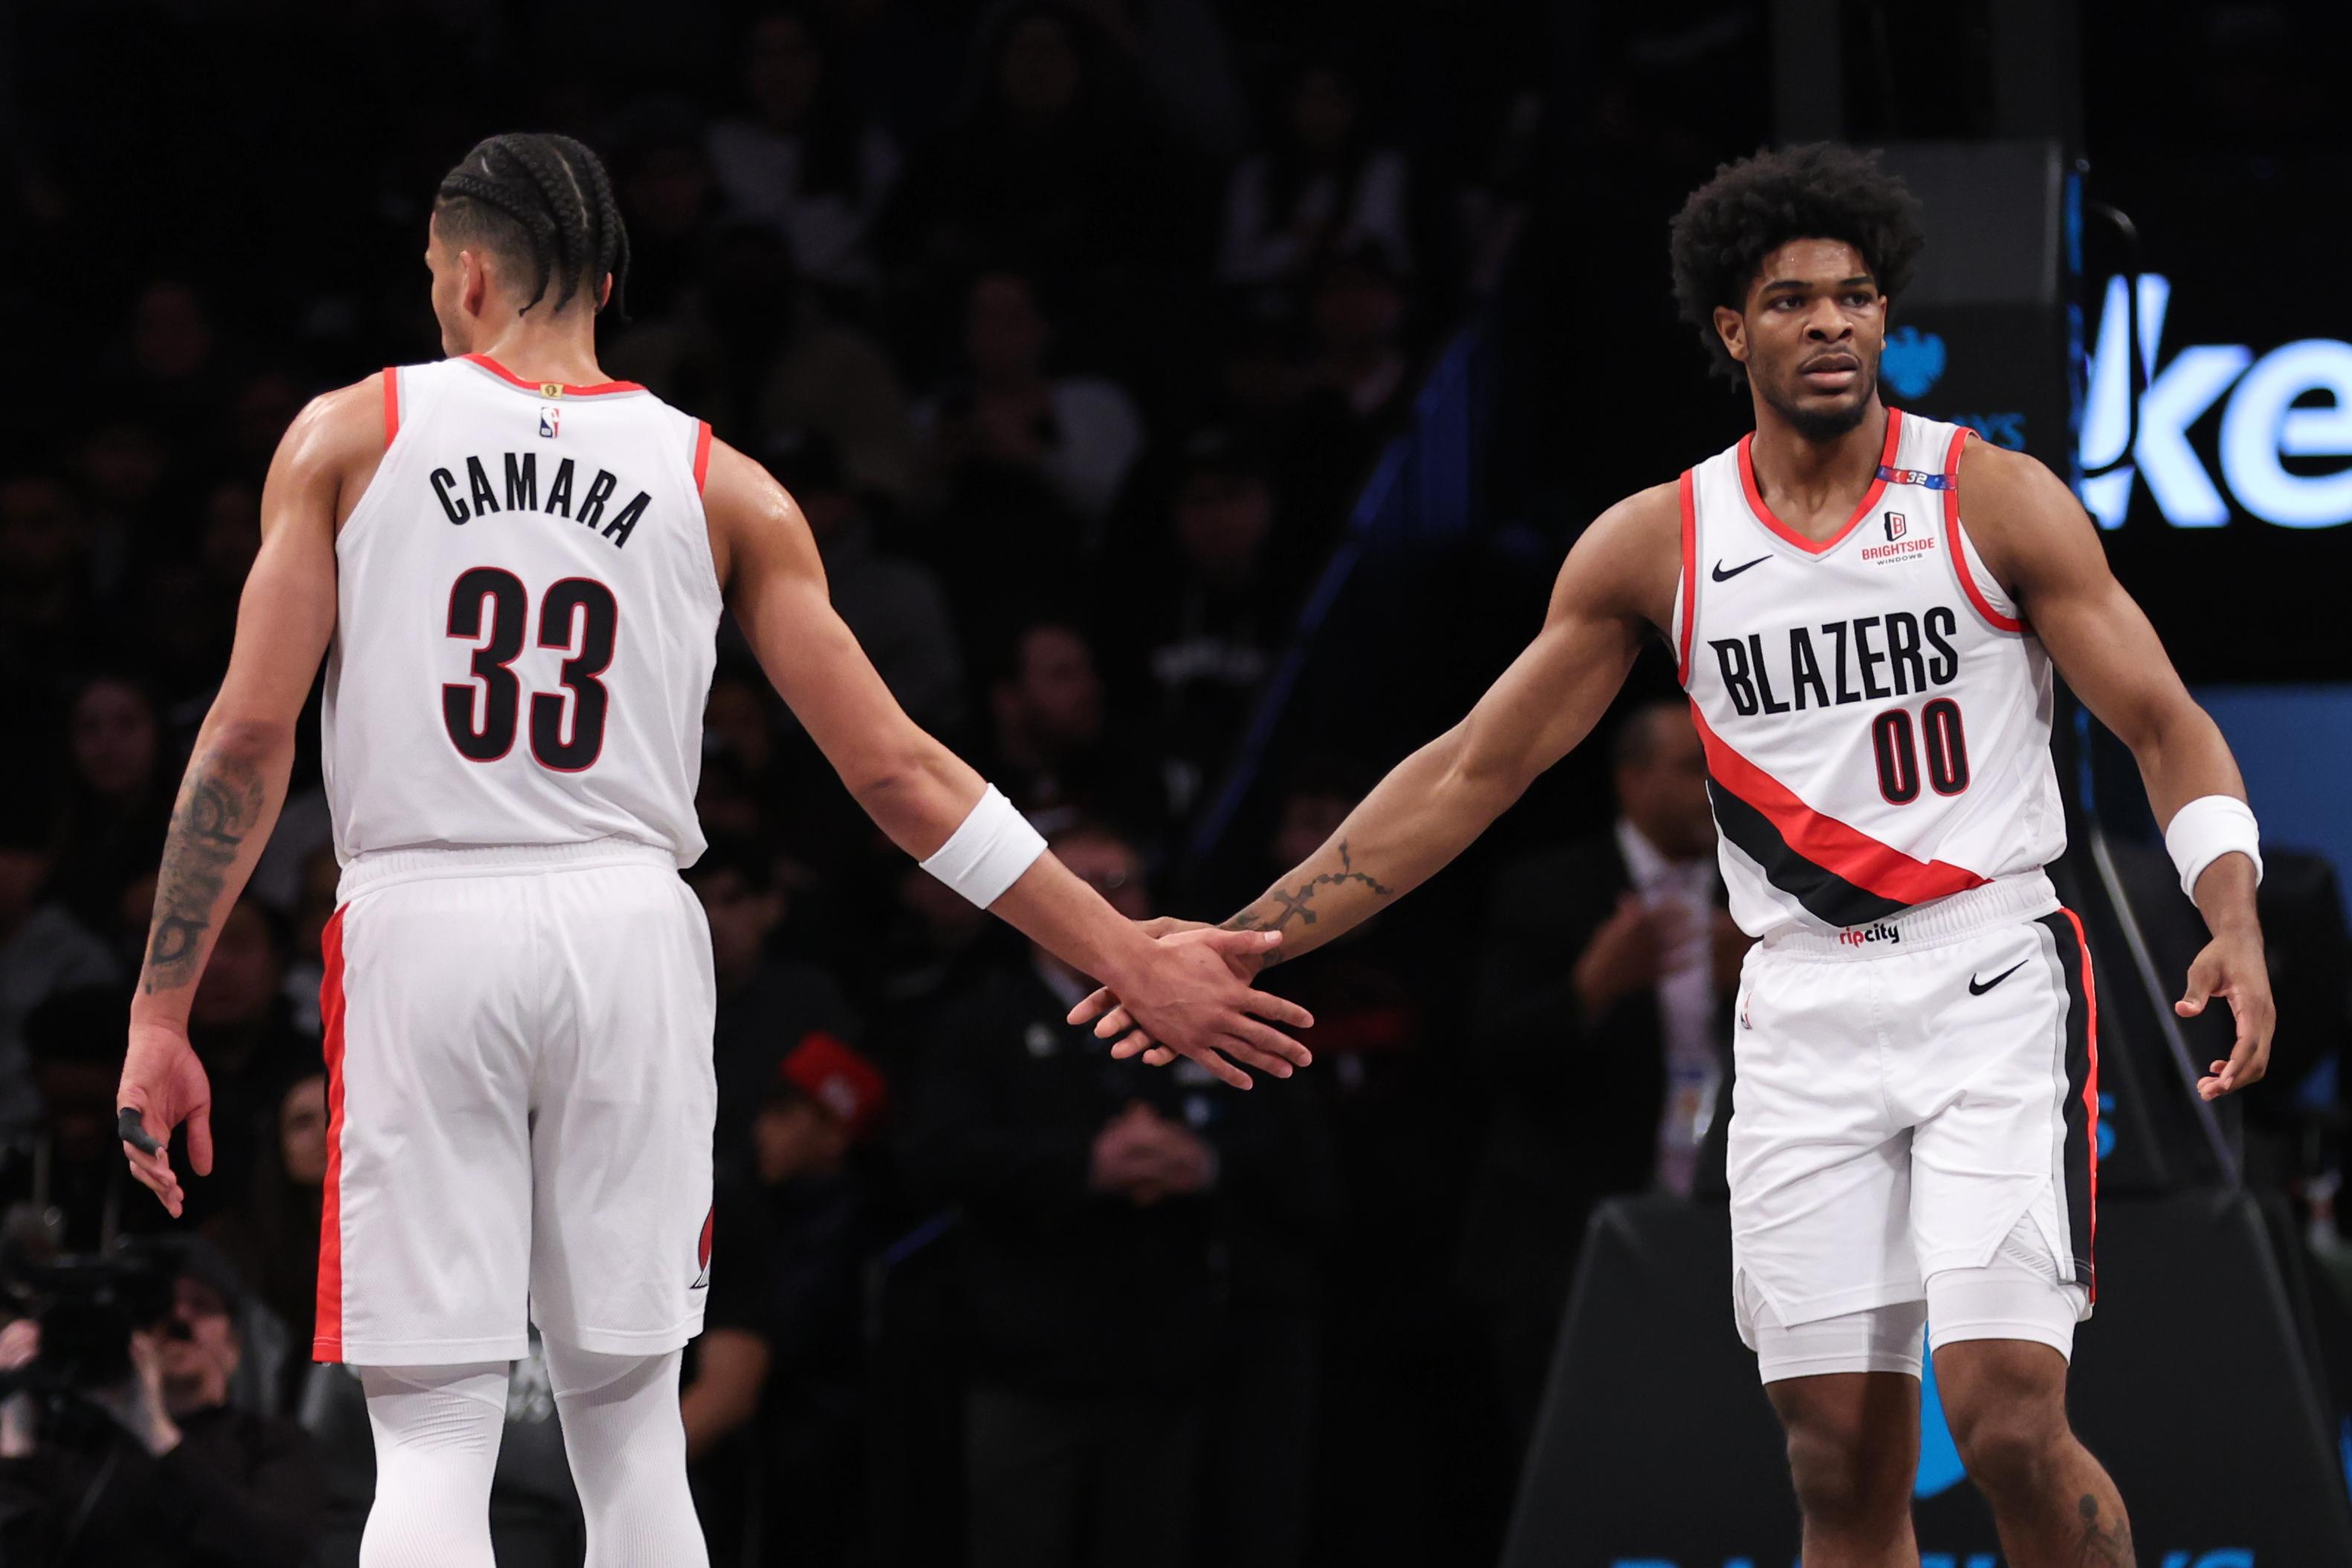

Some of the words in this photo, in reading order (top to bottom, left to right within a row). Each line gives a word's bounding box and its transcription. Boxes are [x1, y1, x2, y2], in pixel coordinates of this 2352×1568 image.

[2079, 272, 2352, 530] ke
[430, 452, 652, 549] CAMARA
[1893, 516, 1903, 534] B
[1906, 471, 1928, 485] 32
[1862, 537, 1935, 560] BRIGHTSIDE
[1877, 553, 1923, 566] WINDOWS
[441, 566, 618, 773] 33
[1707, 606, 1958, 716] BLAZERS
[1872, 697, 1971, 806] 00
